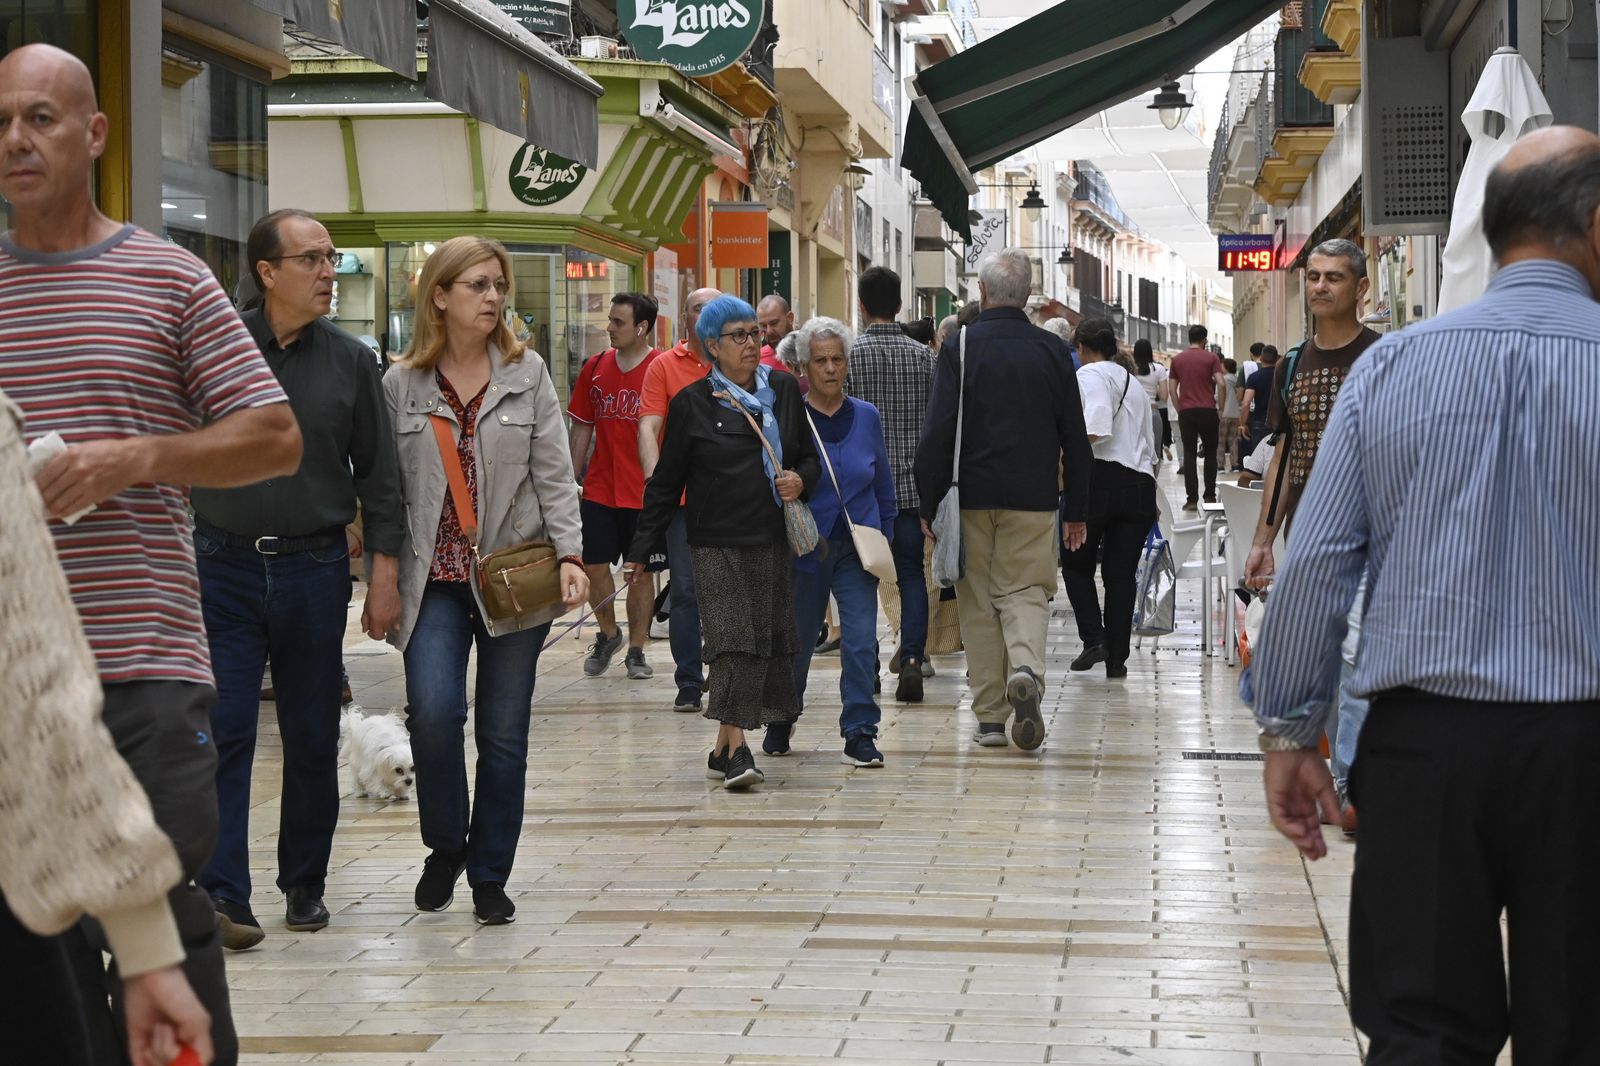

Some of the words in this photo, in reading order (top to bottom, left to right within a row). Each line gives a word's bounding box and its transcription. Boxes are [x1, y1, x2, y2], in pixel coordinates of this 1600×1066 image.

[522, 4, 539, 12] Moda
[697, 62, 708, 70] en
[709, 53, 726, 67] 1915
[716, 236, 762, 245] bankinter
[1220, 238, 1244, 248] óptica
[1226, 251, 1271, 269] 11:49
[649, 553, 667, 564] GAP
